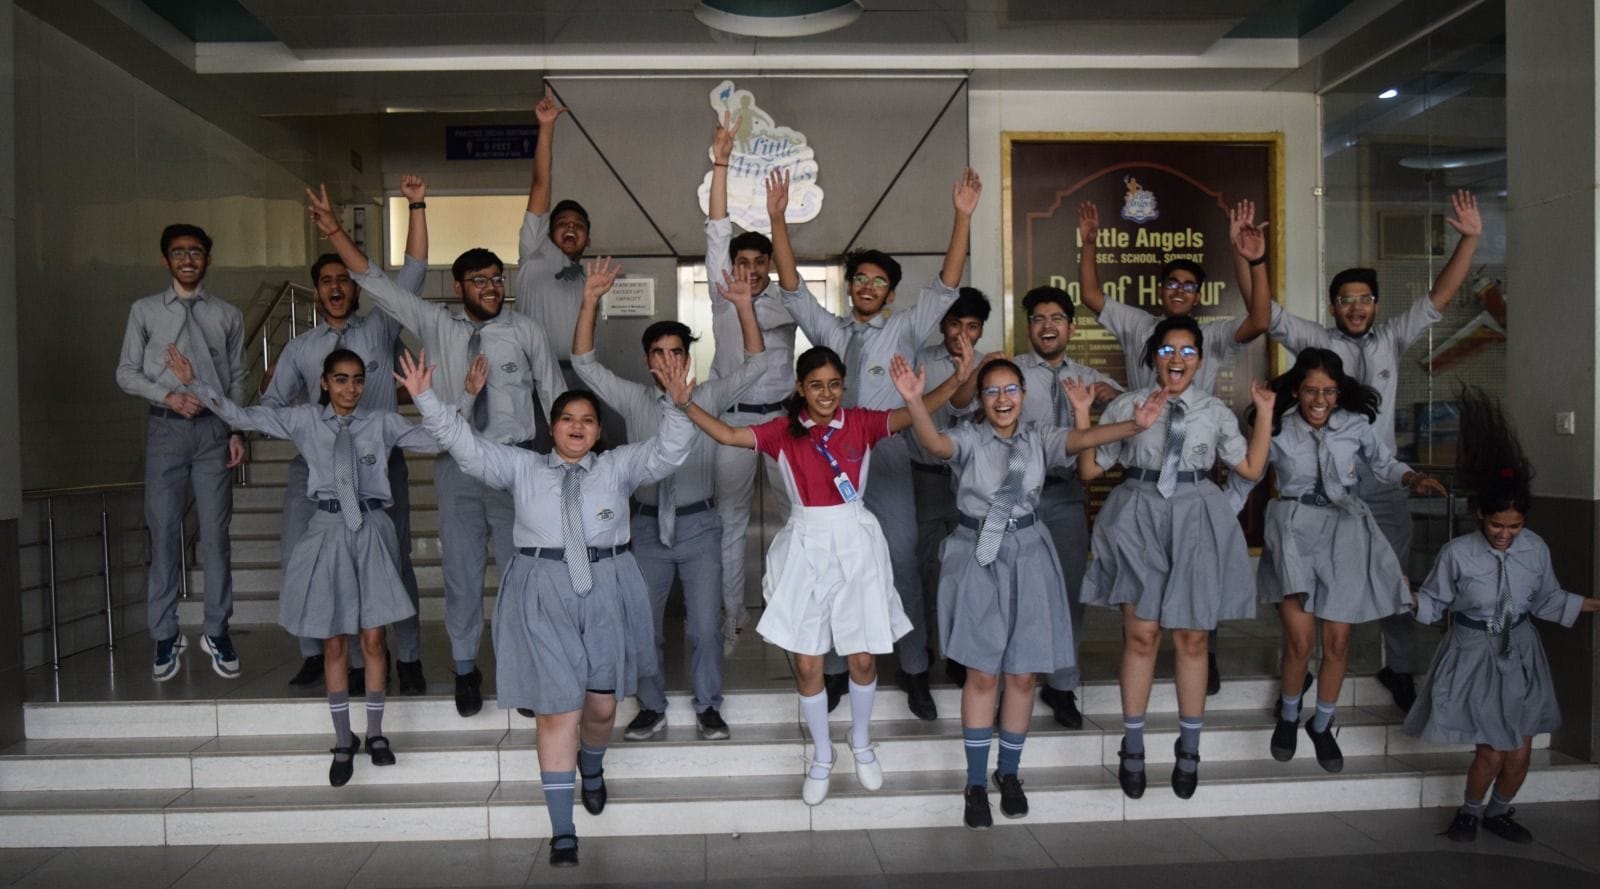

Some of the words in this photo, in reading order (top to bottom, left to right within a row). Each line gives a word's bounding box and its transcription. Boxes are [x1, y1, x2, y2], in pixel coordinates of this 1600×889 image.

[491, 142, 511, 150] FEET
[751, 136, 801, 160] Little
[1077, 227, 1129, 248] Lttle
[1135, 227, 1204, 252] Angels
[1121, 253, 1161, 265] SCHOOL,
[1103, 275, 1132, 304] of
